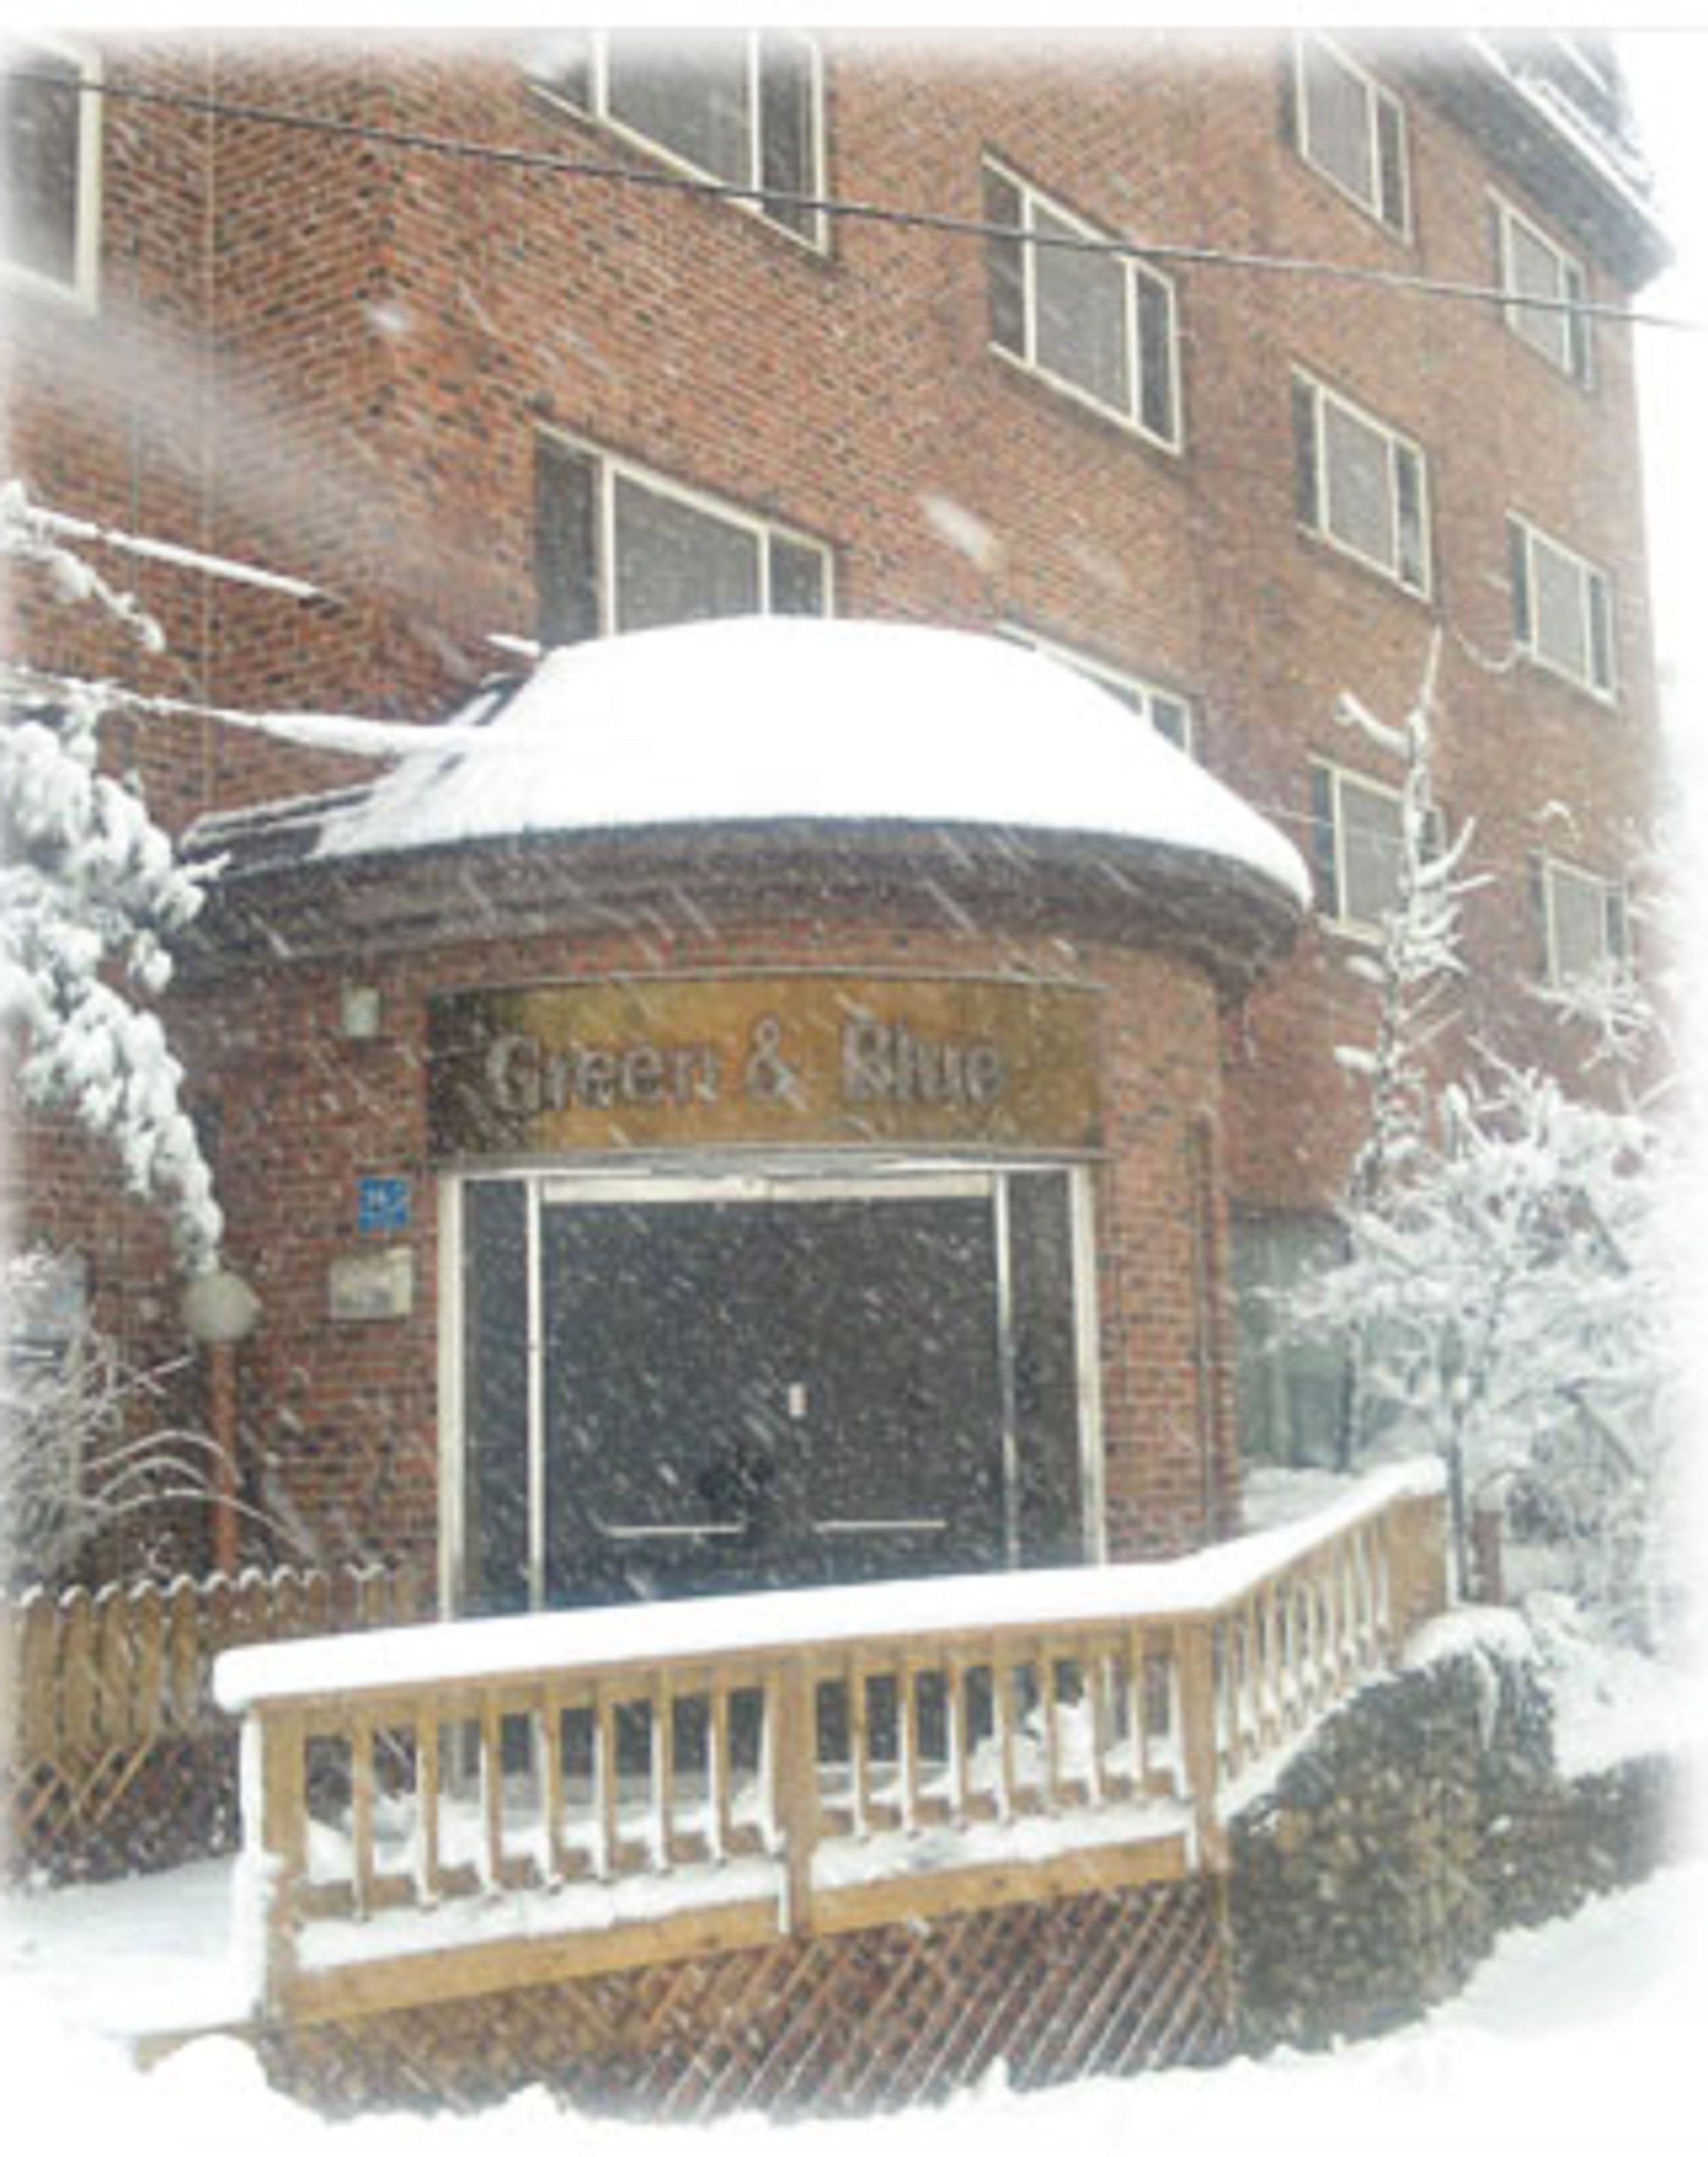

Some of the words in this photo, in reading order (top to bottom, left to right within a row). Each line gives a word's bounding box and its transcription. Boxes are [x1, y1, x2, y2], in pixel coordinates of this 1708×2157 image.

[484, 1033, 720, 1112] Green
[749, 1016, 801, 1102] &
[842, 1016, 1002, 1105] Blue
